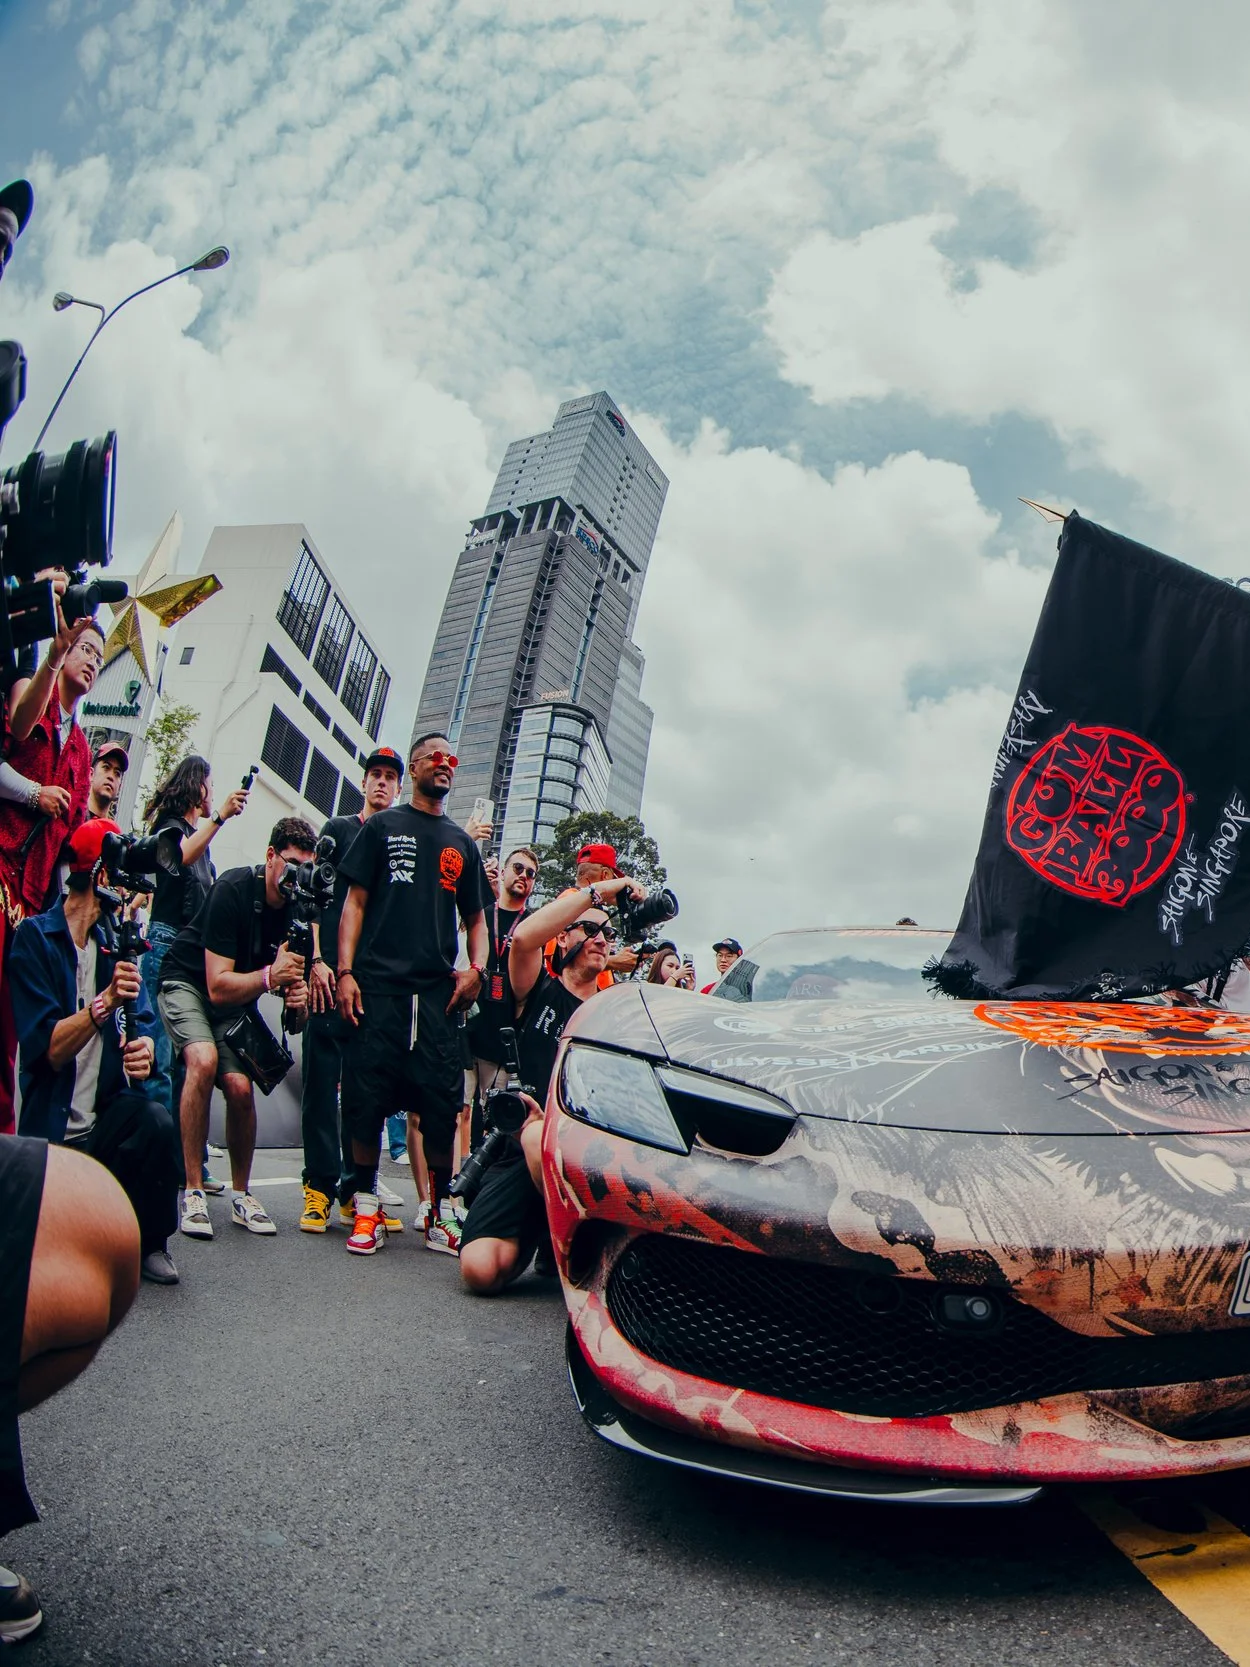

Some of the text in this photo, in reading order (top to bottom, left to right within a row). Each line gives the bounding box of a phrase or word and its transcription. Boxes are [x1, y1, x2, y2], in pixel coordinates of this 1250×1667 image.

[539, 689, 570, 700] FUSION
[1161, 857, 1198, 943] SAIGON
[1057, 1057, 1213, 1100] SAIGON
